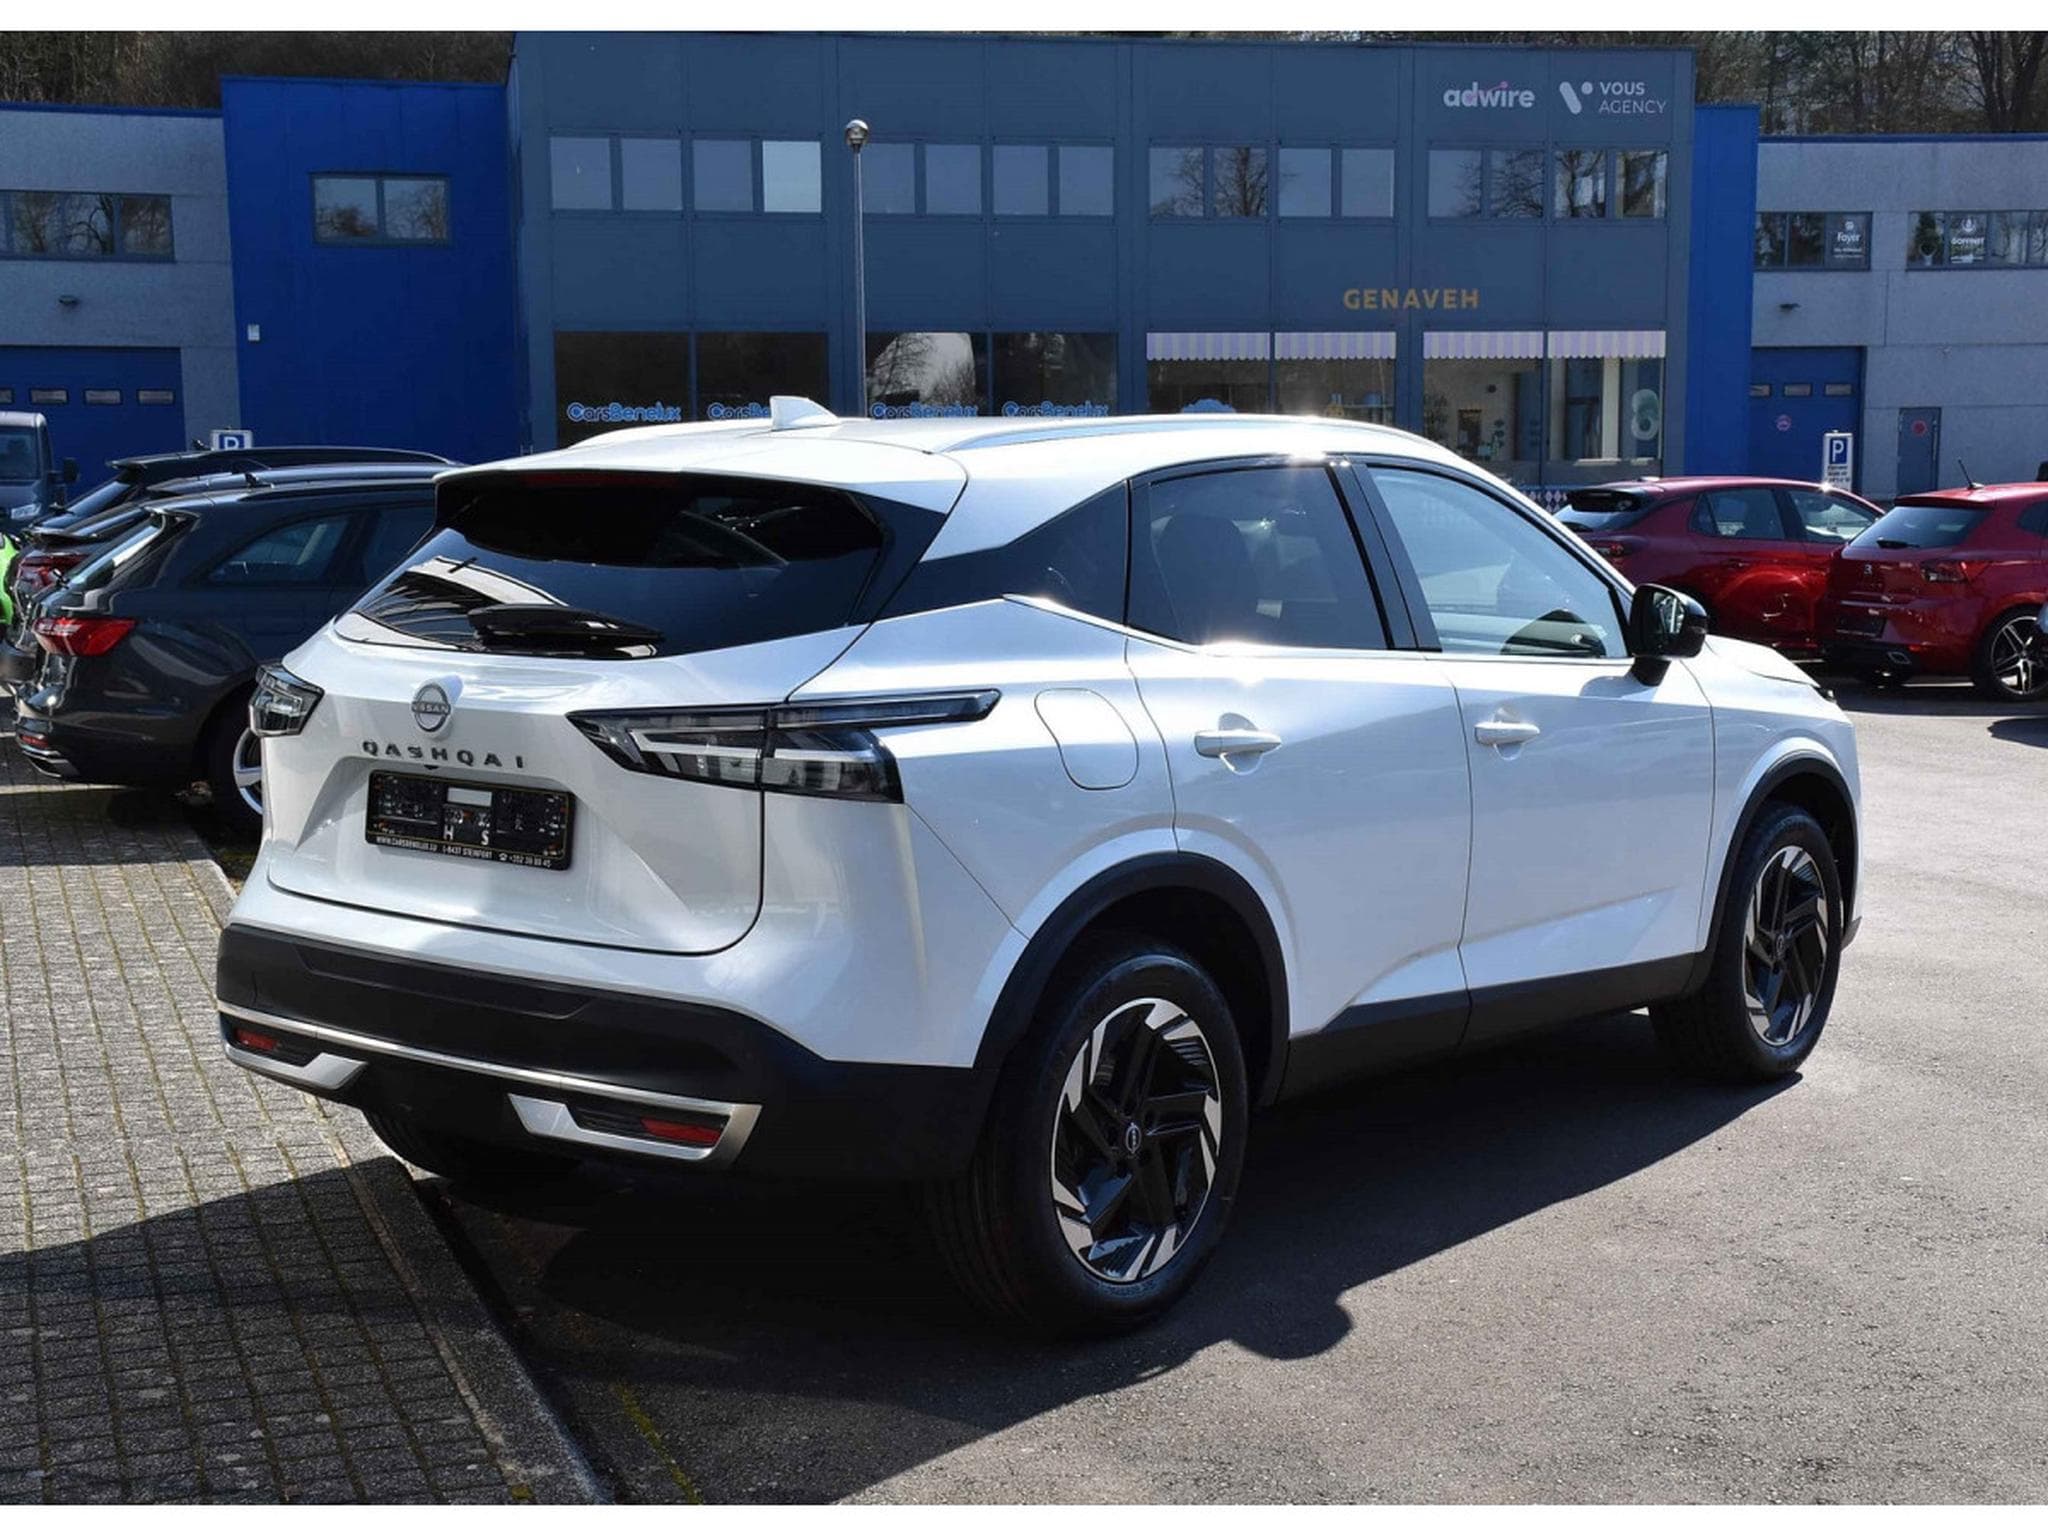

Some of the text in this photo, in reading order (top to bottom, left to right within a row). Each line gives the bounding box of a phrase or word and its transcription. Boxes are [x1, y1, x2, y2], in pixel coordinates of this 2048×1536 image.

[1443, 81, 1536, 108] adwire
[1600, 82, 1646, 96] VOUS
[1599, 99, 1667, 114] AGENCY
[1343, 288, 1480, 310] GENAVEH
[566, 400, 683, 423] CarsBenelux
[1832, 439, 1845, 463] P
[413, 702, 450, 714] NISSAN
[362, 740, 525, 769] QASHQAI
